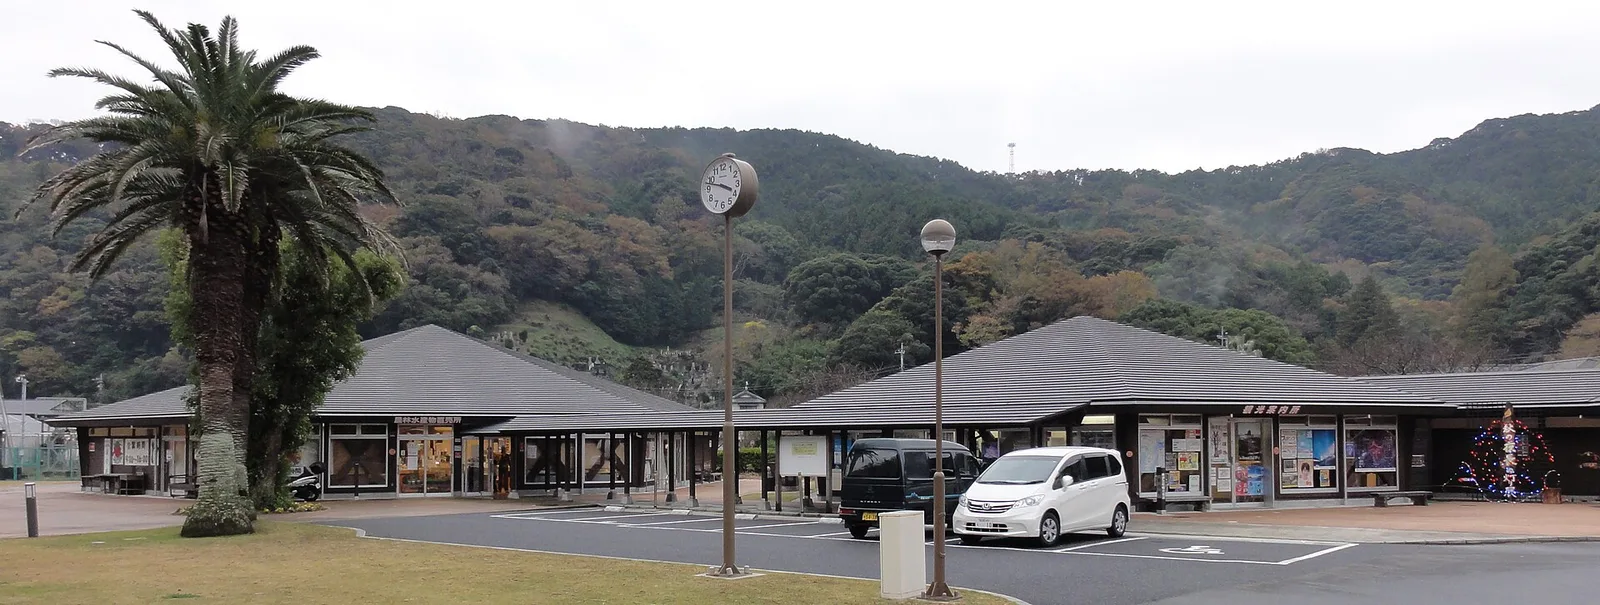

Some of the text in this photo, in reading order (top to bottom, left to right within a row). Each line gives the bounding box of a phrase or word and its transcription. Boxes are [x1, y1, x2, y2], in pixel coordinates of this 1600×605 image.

[713, 167, 719, 175] 11
[720, 163, 726, 171] 12
[729, 165, 732, 173] 1
[733, 170, 738, 178] 2
[708, 176, 715, 184] 10
[733, 189, 737, 197] 4
[715, 200, 719, 208] 7
[1242, 405, 1301, 414] 観光案内所
